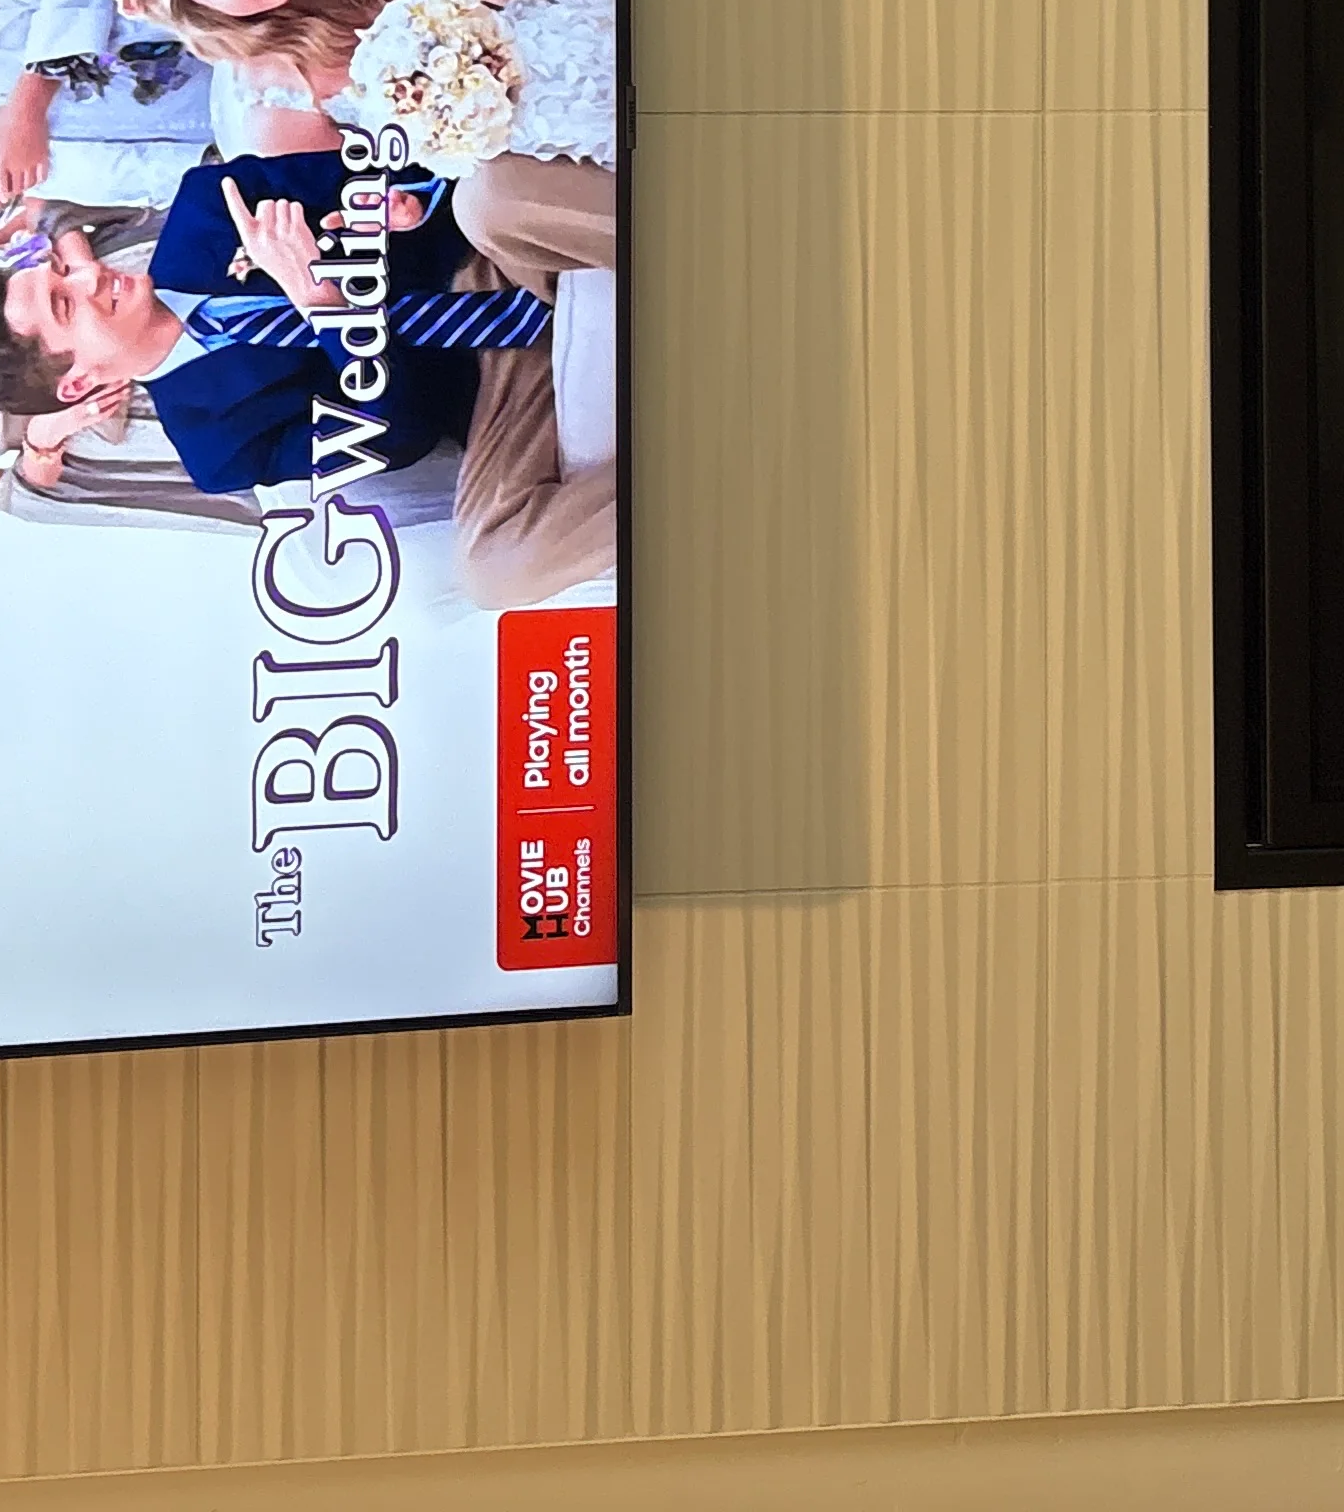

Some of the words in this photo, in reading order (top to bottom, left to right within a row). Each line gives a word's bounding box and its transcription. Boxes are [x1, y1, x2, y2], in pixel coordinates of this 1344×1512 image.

[308, 123, 408, 501] Wedding
[252, 495, 398, 853] BIG
[564, 636, 590, 741] month
[522, 670, 558, 788] Playing
[564, 750, 590, 786] all
[254, 847, 302, 947] The
[521, 840, 544, 940] MOVIE
[546, 867, 569, 937] HUB
[573, 838, 591, 936] Channels
